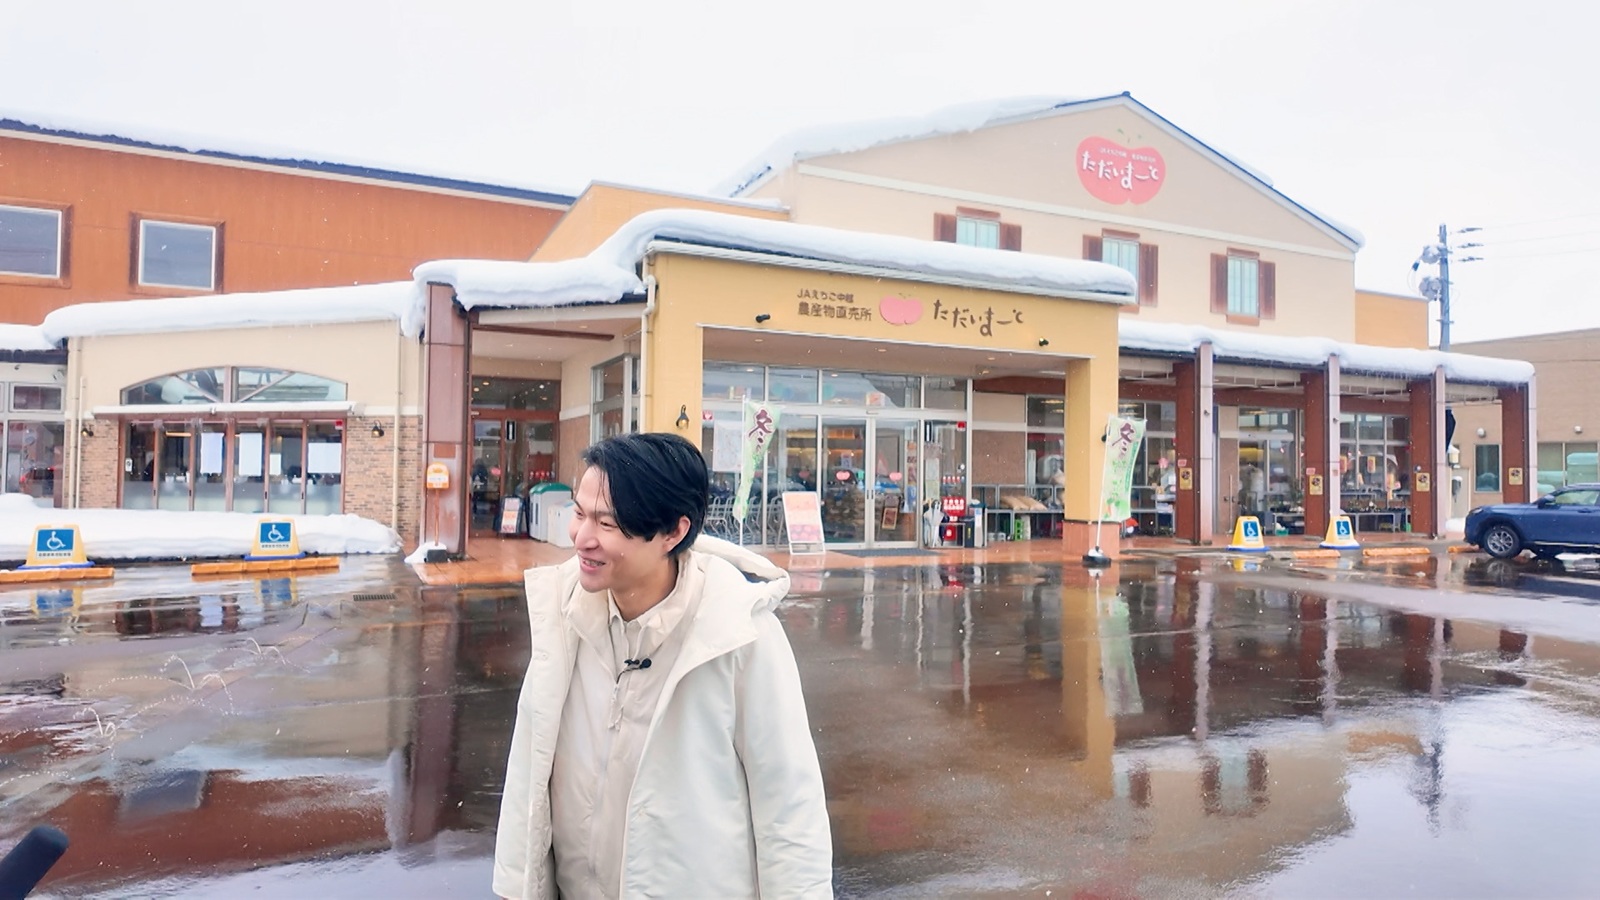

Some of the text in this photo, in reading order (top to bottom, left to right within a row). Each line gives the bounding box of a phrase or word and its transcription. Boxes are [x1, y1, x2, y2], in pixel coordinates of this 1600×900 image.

[1082, 152, 1159, 190] ただいまーと
[798, 301, 872, 321] 農産物直売所
[933, 300, 1024, 336] ただいまーと
